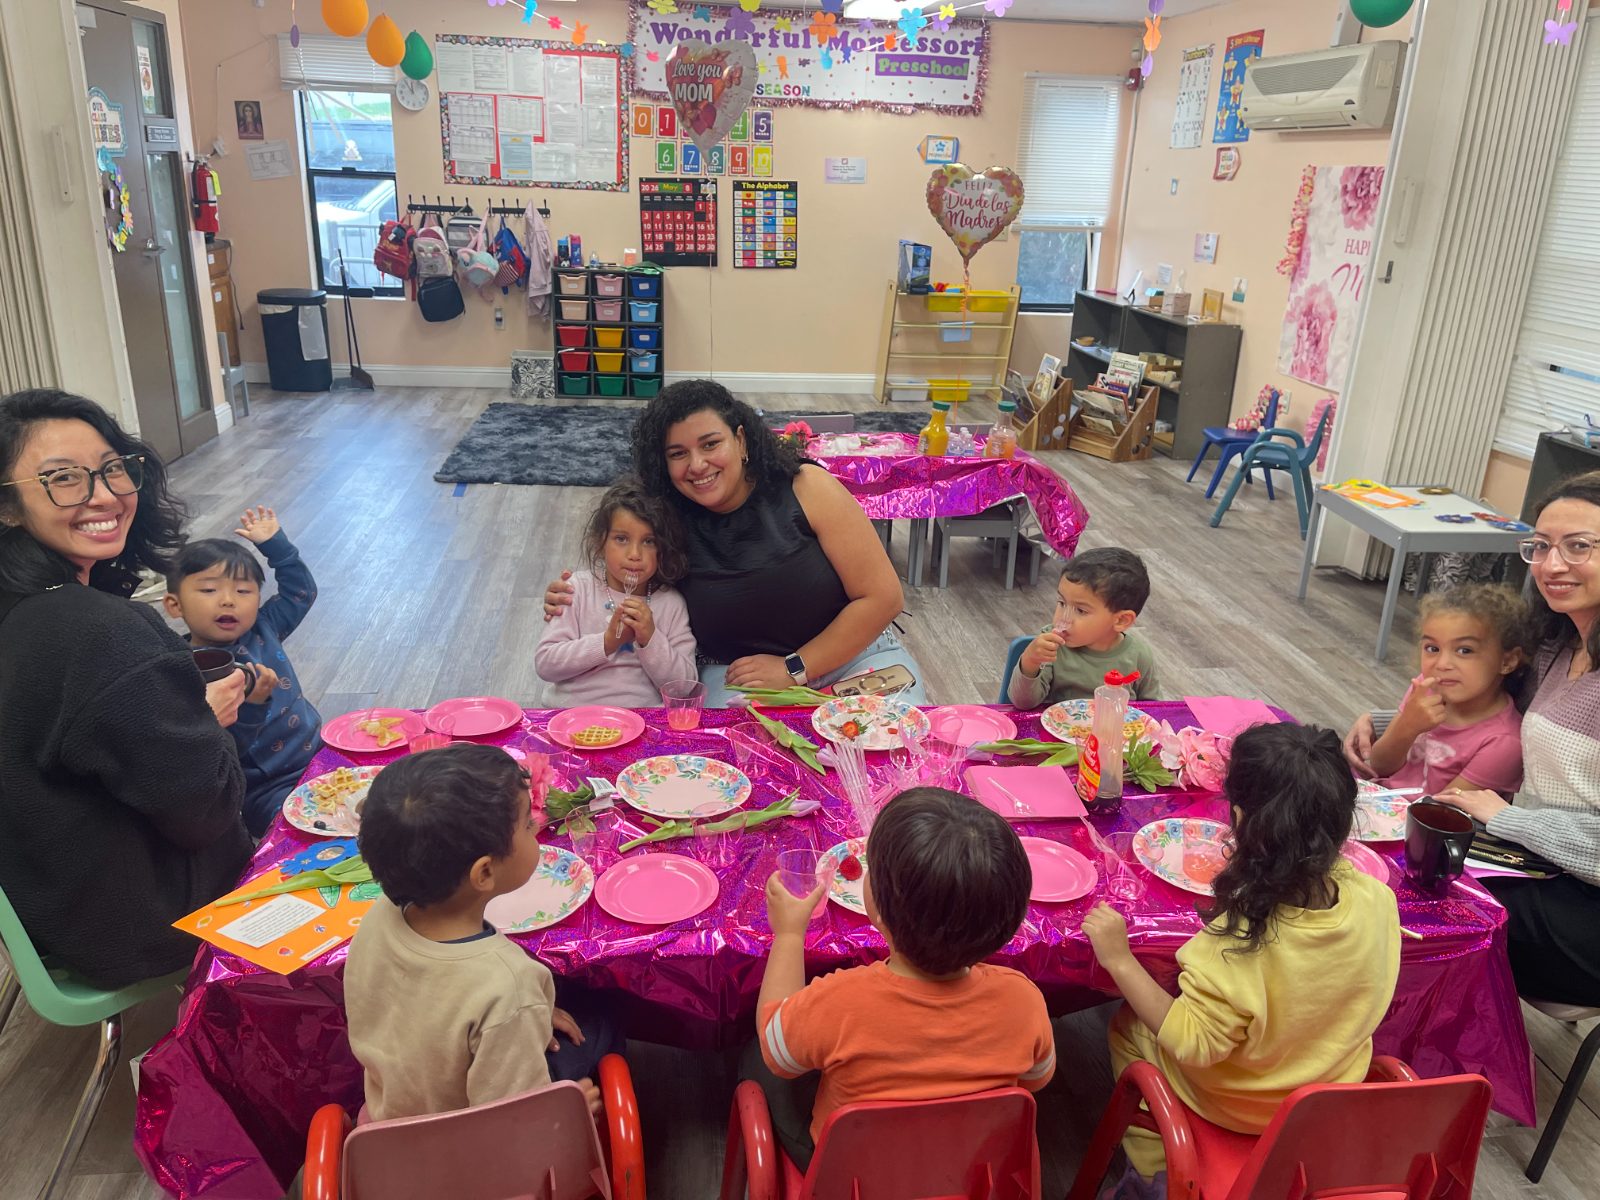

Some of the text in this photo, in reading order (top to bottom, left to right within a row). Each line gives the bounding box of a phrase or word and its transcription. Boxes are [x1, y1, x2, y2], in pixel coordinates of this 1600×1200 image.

[650, 22, 983, 56] Wondrful Monessori
[672, 59, 722, 82] Love you
[878, 58, 968, 76] Preschool
[675, 83, 713, 102] MOM
[756, 84, 811, 96] SEASON
[638, 112, 648, 128] 0
[665, 114, 670, 128] 1
[758, 118, 767, 132] 5
[662, 149, 670, 164] 6
[688, 150, 696, 165] 7
[712, 151, 720, 166] 8
[735, 152, 742, 166] 9
[976, 192, 990, 208] de
[992, 193, 1011, 214] las
[946, 209, 1003, 229] Madres
